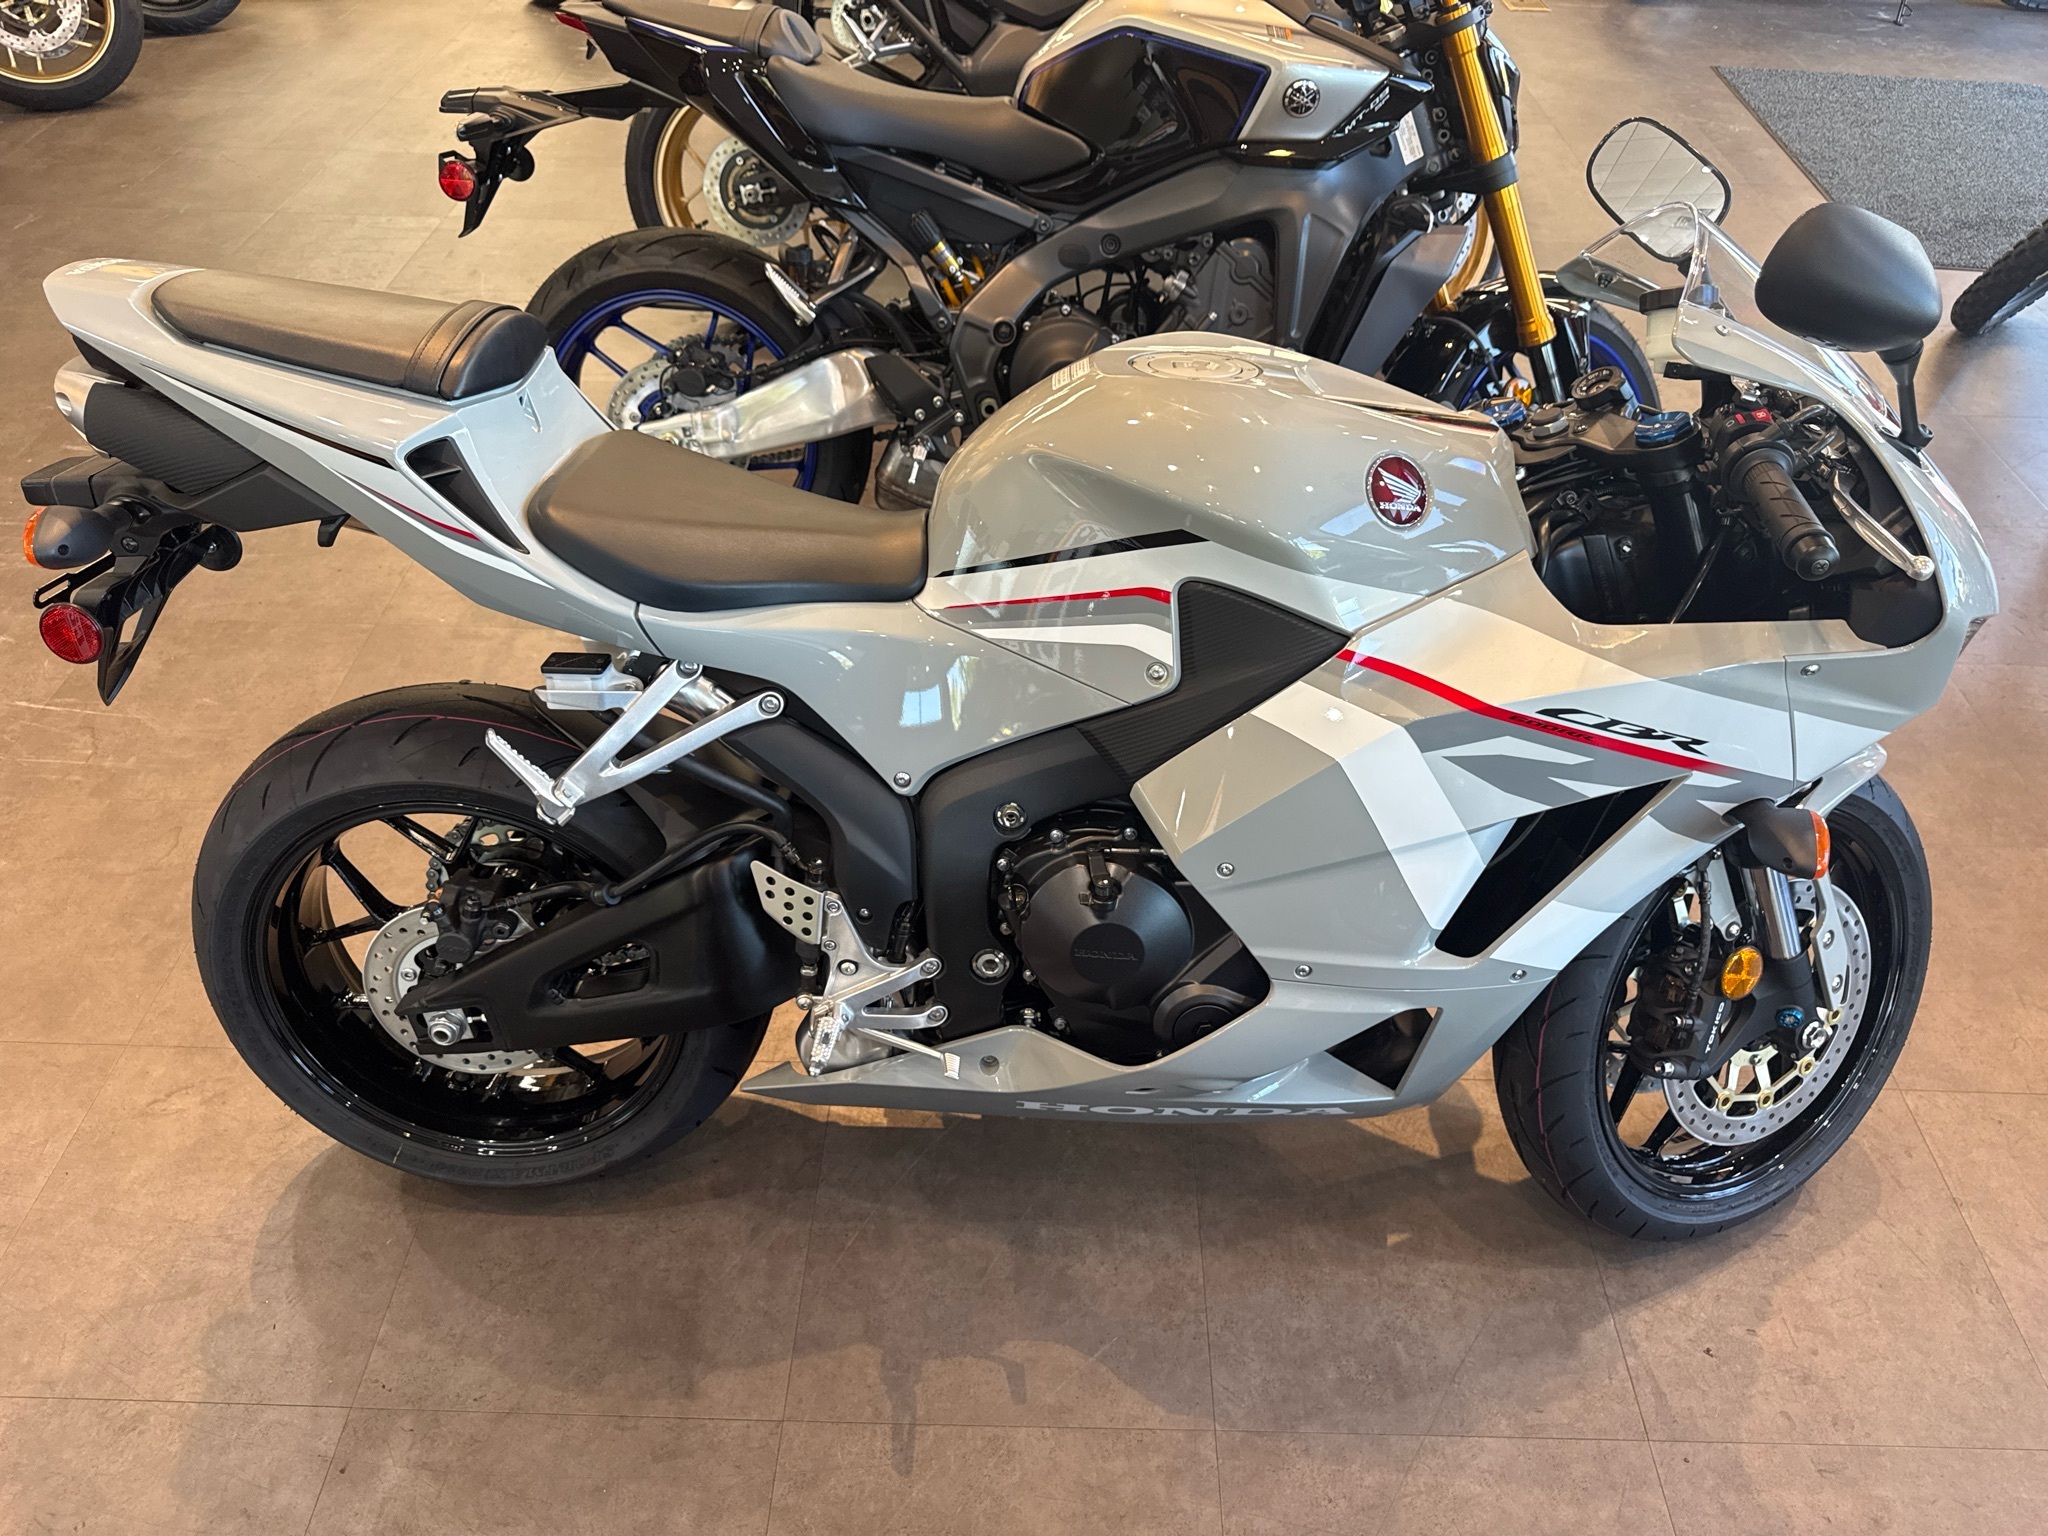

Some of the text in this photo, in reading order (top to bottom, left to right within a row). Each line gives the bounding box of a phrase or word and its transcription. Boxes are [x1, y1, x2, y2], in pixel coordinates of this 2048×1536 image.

[1379, 502, 1422, 512] HONDA
[1508, 714, 1595, 742] 600RR
[1535, 708, 1710, 757] CBR
[1074, 948, 1139, 961] HONDA
[1704, 1001, 1725, 1054] TOKICO
[1015, 1100, 1355, 1116] HONDA
